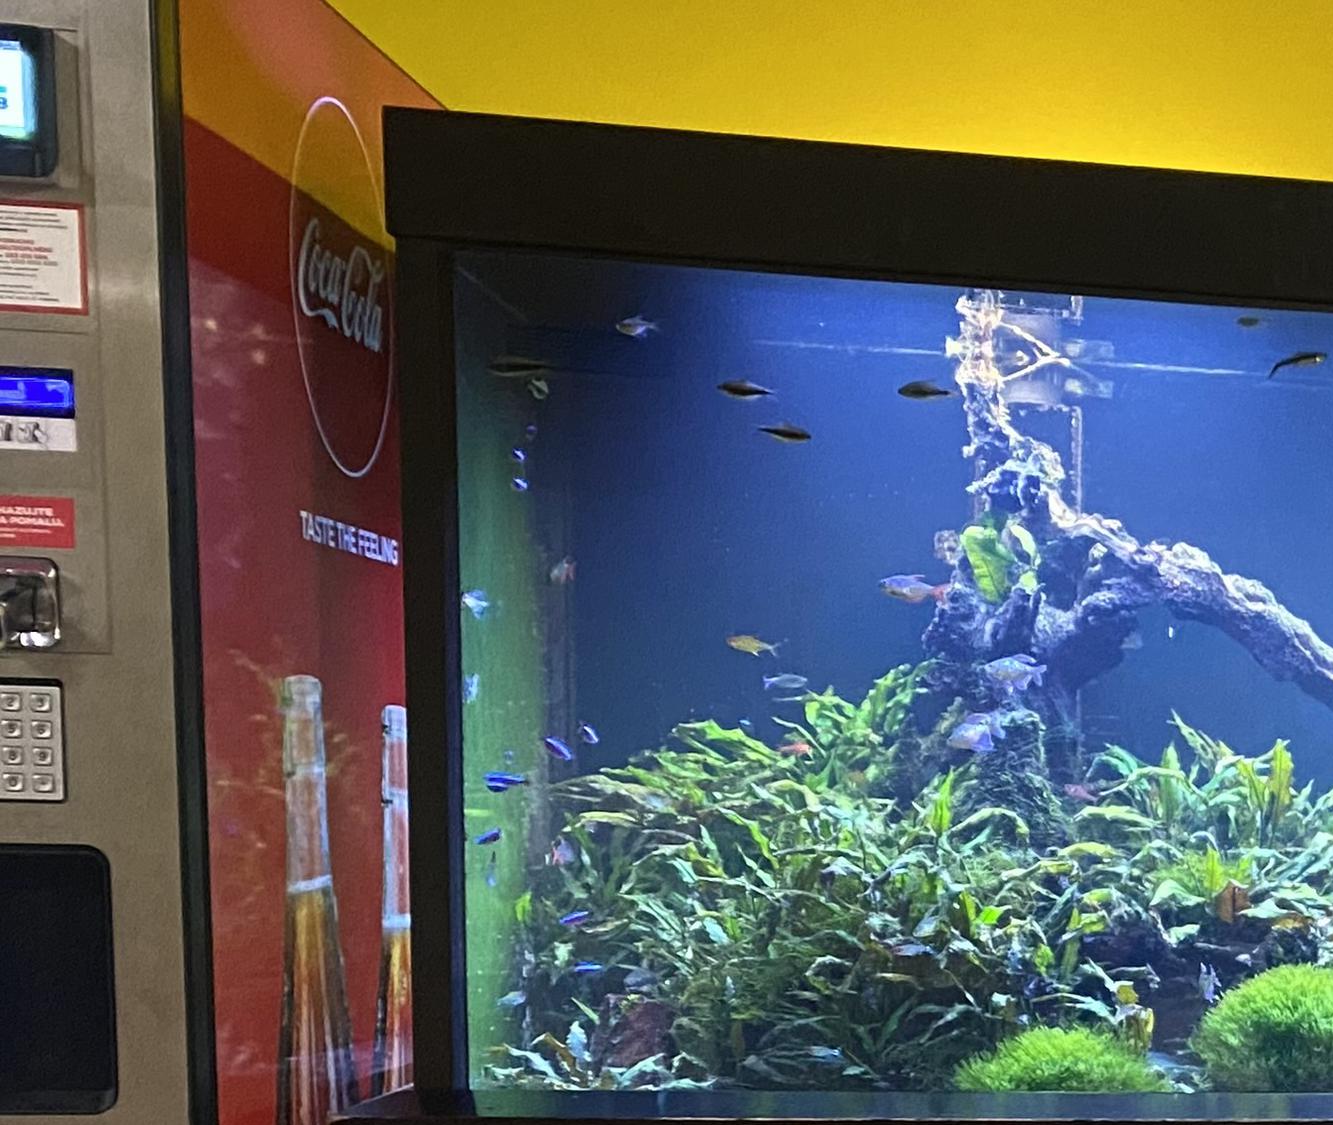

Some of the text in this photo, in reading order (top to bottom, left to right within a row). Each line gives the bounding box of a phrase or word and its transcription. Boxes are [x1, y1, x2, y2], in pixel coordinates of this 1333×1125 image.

[300, 510, 399, 567] TASTE THE FEELING
